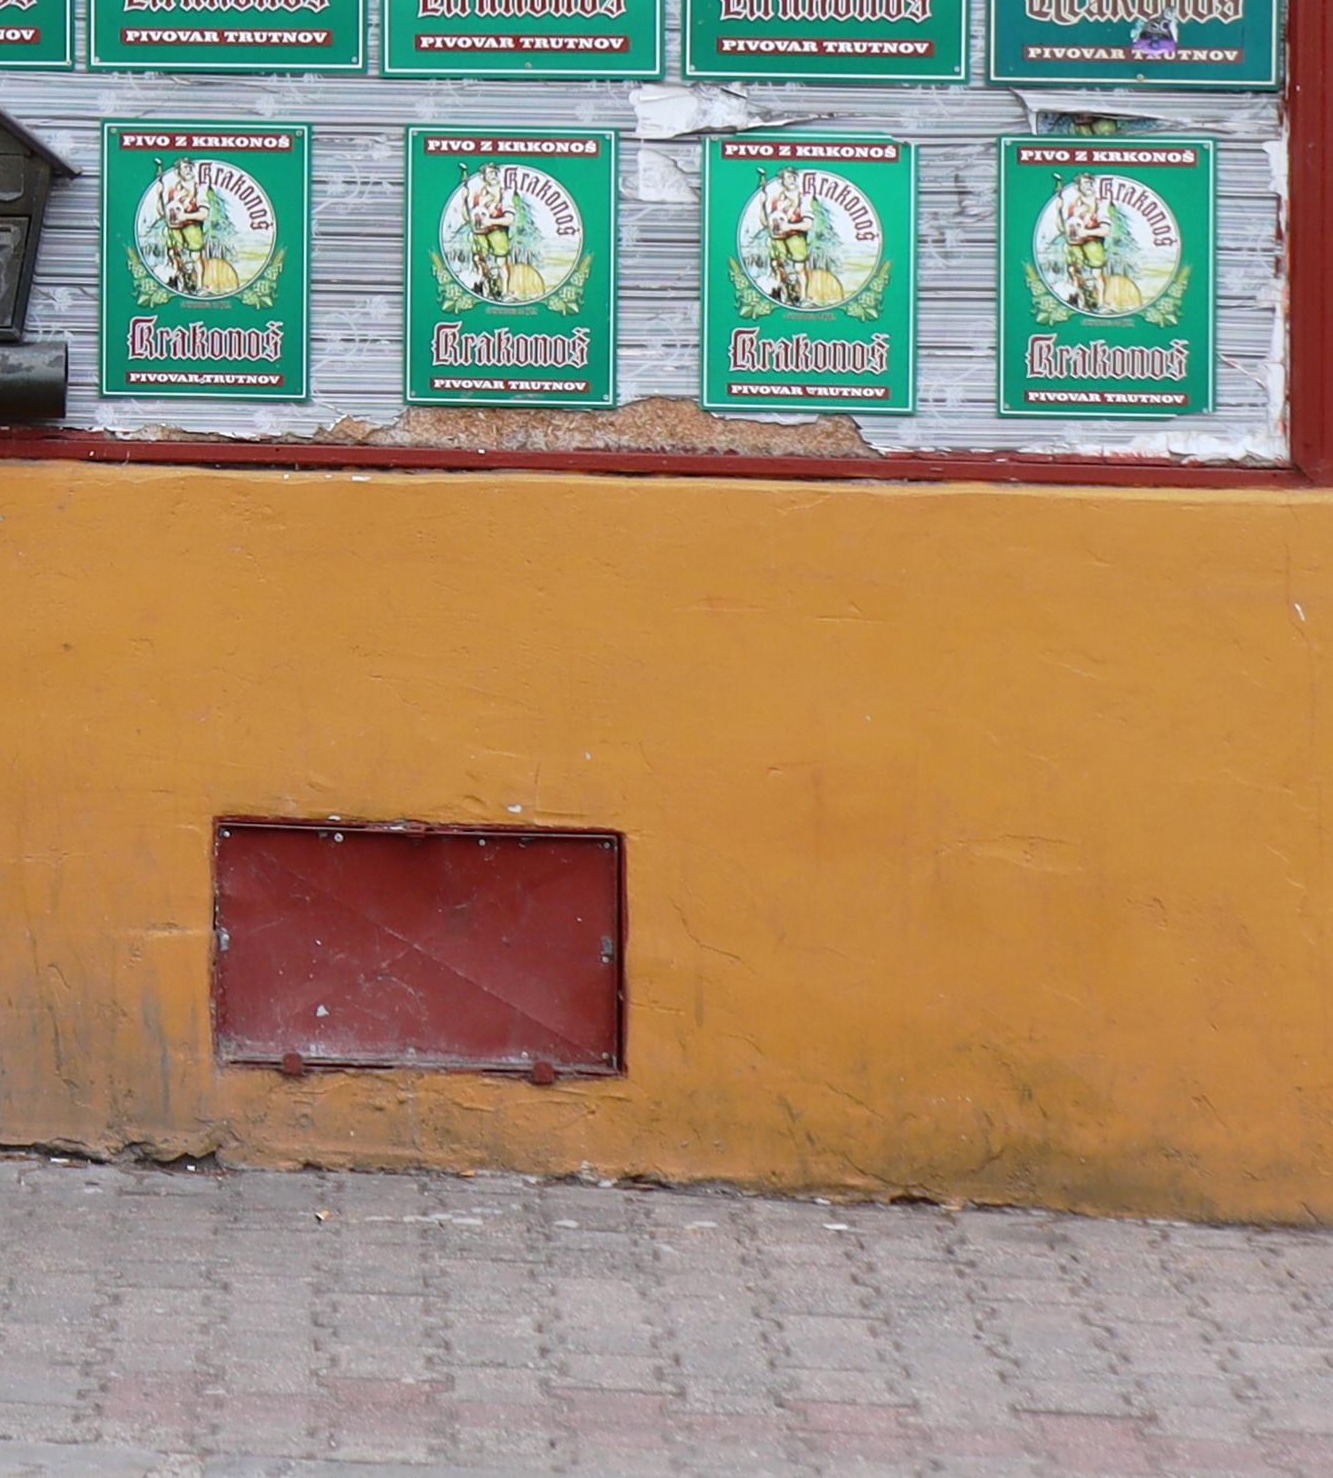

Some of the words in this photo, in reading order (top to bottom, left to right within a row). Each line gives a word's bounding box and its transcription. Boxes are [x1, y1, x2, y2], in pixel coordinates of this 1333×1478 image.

[126, 30, 220, 43] PIVOVAR
[223, 31, 328, 44] TRUTNOV
[420, 36, 515, 49] PIVOVAR
[519, 37, 624, 50] TRUTNOV
[722, 39, 819, 53] PIVOVAR
[822, 41, 929, 54] TRUTNOV
[1028, 47, 1126, 60] PIVOVAR
[122, 135, 171, 147] PIVO
[175, 135, 188, 147] Z
[192, 134, 290, 148] KRKONOŠ
[427, 139, 476, 152] PIVO
[480, 140, 493, 152] Z
[497, 137, 597, 154] KRKONOŠ
[724, 144, 774, 156] PIVO
[778, 145, 792, 157] Z
[795, 144, 897, 159] KRKONOŠ
[1020, 149, 1071, 162] PIVO
[1074, 150, 1088, 162] Z
[1092, 149, 1195, 164] KRKONOŠ
[128, 315, 284, 362] Krakonoš
[431, 320, 591, 368] Krakonoš
[729, 326, 891, 375] Krakonoš
[1026, 333, 1189, 381] Krakonoš
[129, 372, 202, 385] PIVOVAR
[201, 373, 281, 386] TRUTNOV
[433, 378, 506, 390] PIVOVAR
[507, 380, 587, 391] TRUTNOV
[731, 384, 804, 396] PIVOVAR
[805, 386, 886, 397] TRUTNOV
[1028, 391, 1102, 403] PIVOVAR
[1103, 393, 1185, 404] TRUTNOV
